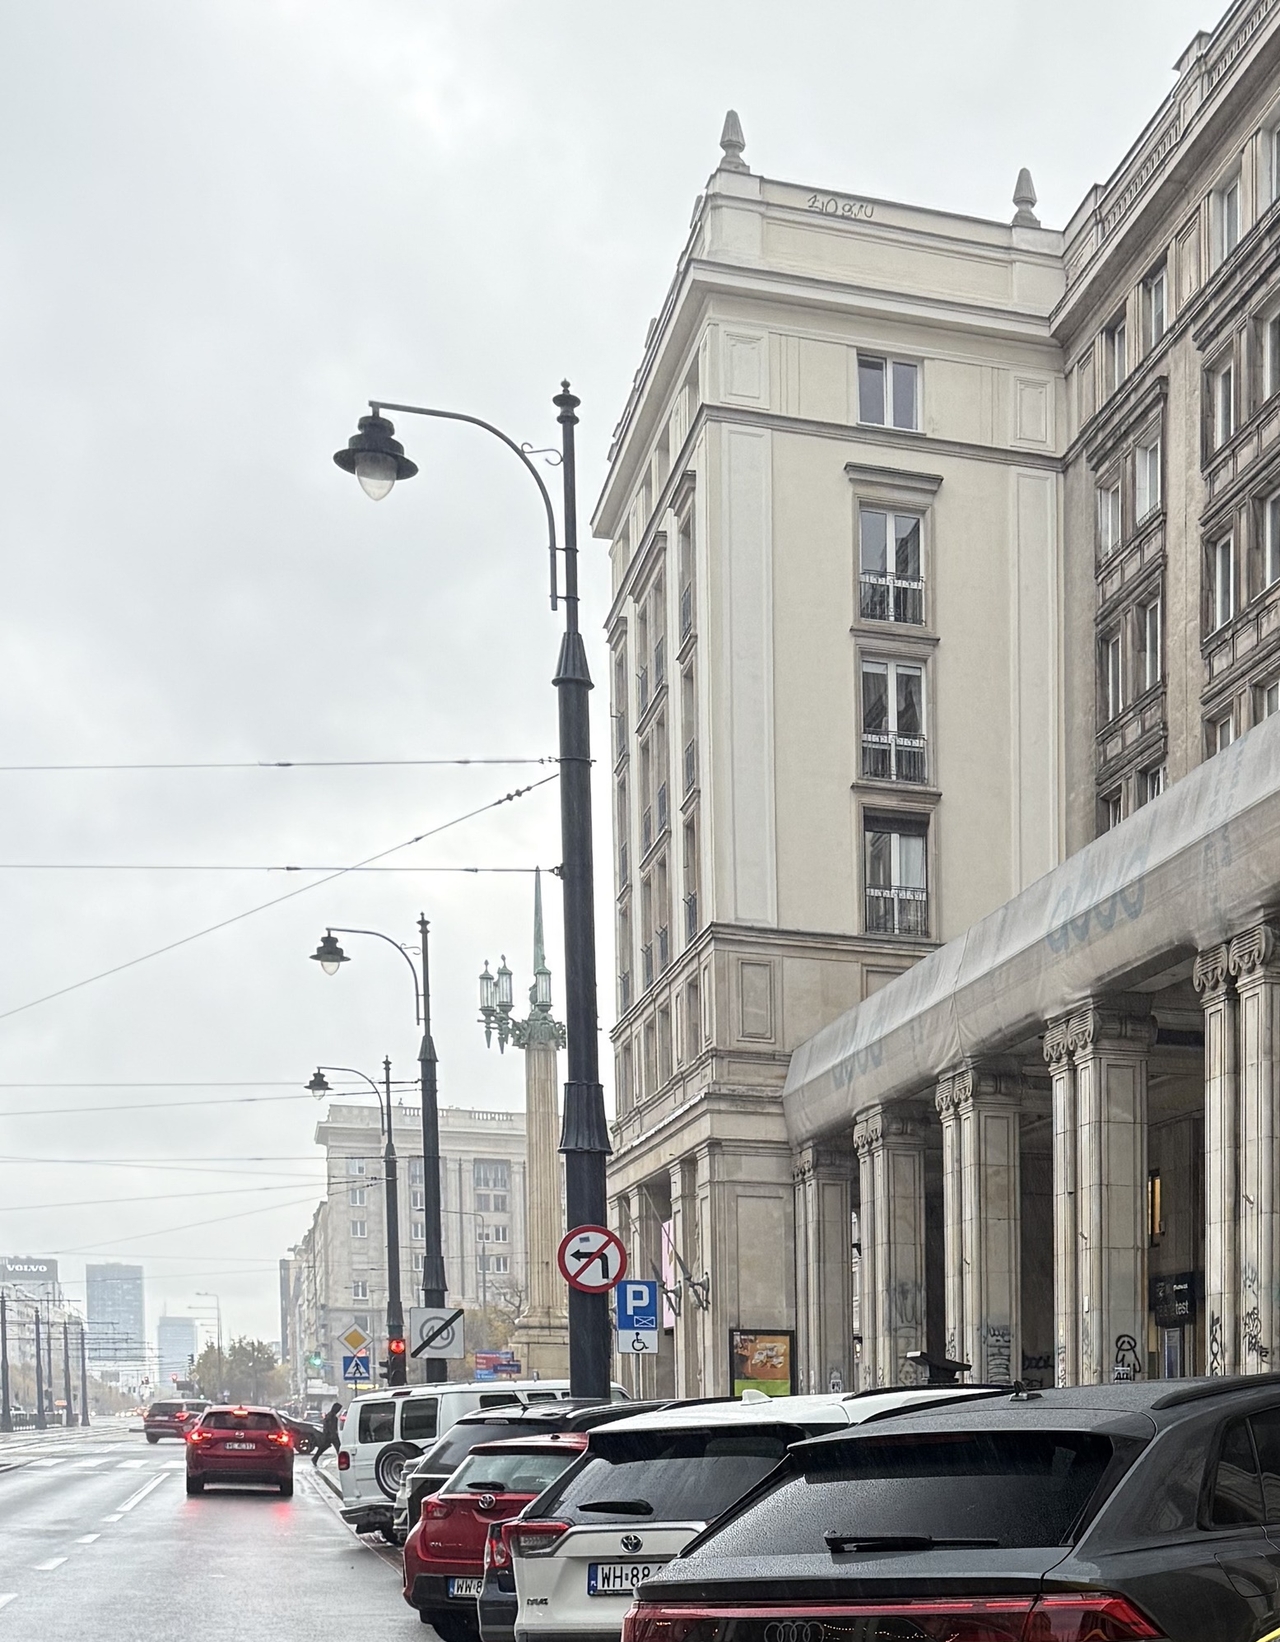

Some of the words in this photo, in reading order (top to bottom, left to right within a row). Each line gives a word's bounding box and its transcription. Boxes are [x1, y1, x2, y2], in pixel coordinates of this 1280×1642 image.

[6, 1264, 48, 1272] VOLVO
[626, 1284, 650, 1315] P
[456, 1579, 473, 1593] WW
[601, 1566, 623, 1588] WH
